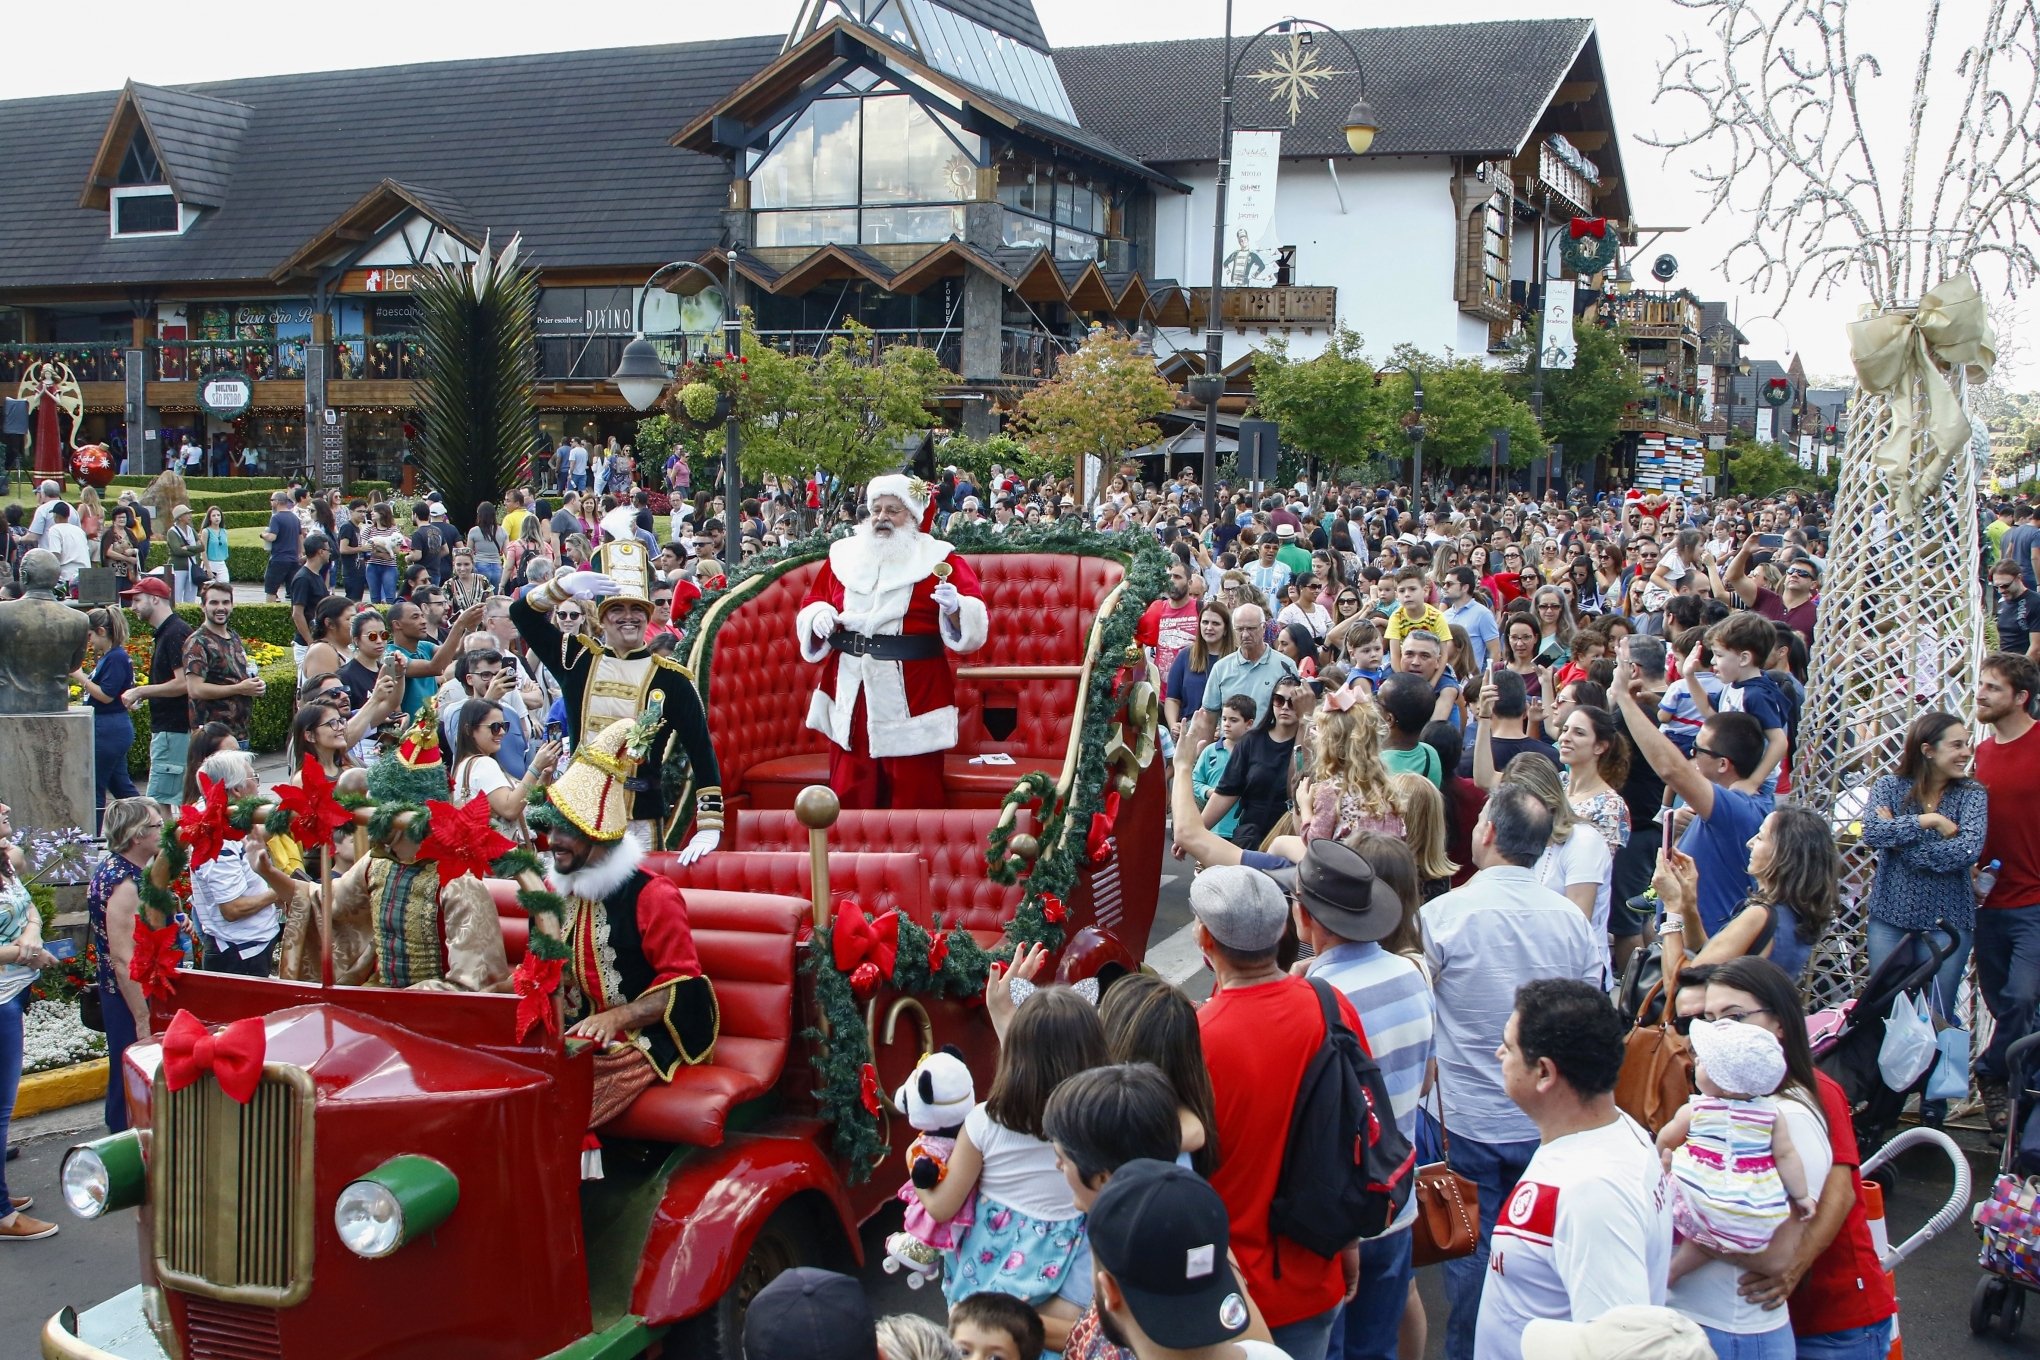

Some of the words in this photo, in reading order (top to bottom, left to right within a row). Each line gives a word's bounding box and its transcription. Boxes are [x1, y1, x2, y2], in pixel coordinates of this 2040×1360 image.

[238, 307, 265, 324] Casa
[269, 306, 292, 324] São
[554, 316, 578, 324] escolher
[586, 308, 631, 329] DIVINO
[211, 392, 222, 405] SÃO
[223, 393, 242, 405] PEDRO
[1489, 1251, 1505, 1277] ul
